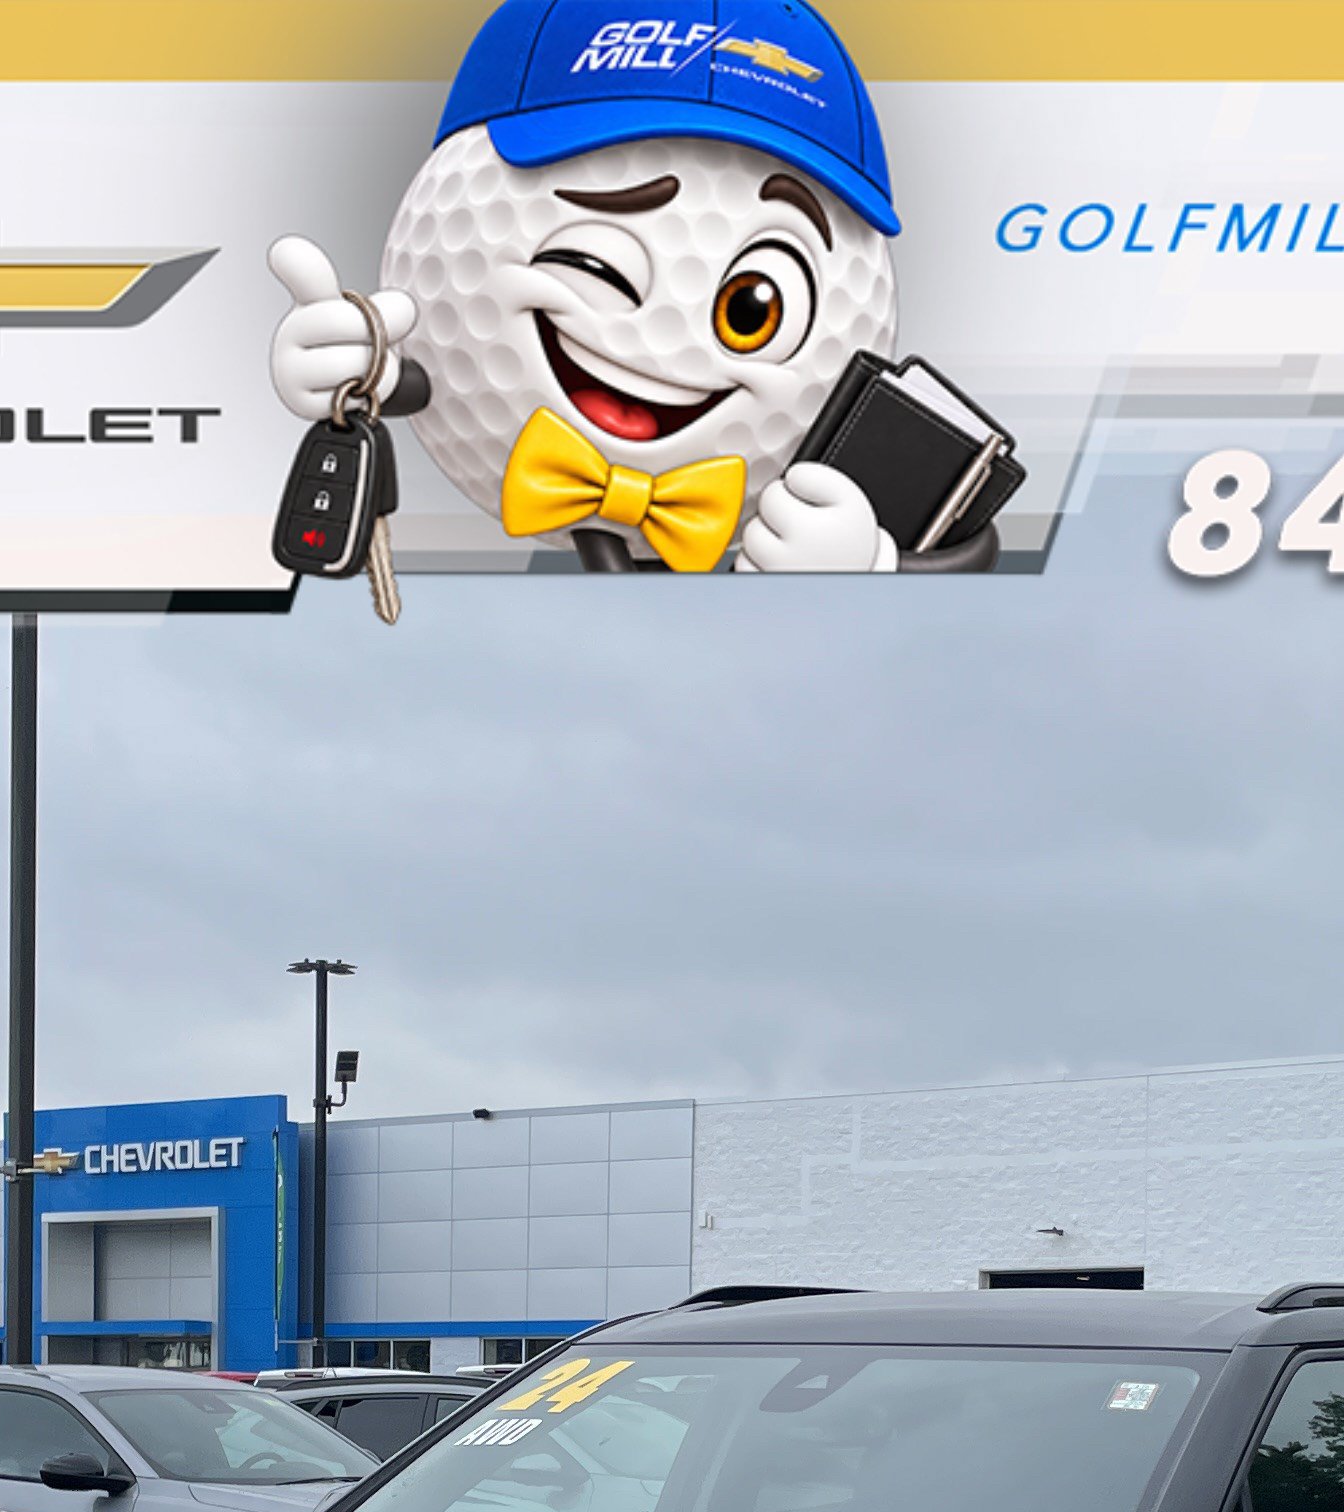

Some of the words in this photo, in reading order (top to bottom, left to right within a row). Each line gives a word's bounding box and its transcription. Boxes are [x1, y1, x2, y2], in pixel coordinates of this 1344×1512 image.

[84, 1136, 245, 1175] CHEVROLET
[494, 1357, 636, 1414] 24
[453, 1418, 544, 1446] AWD
